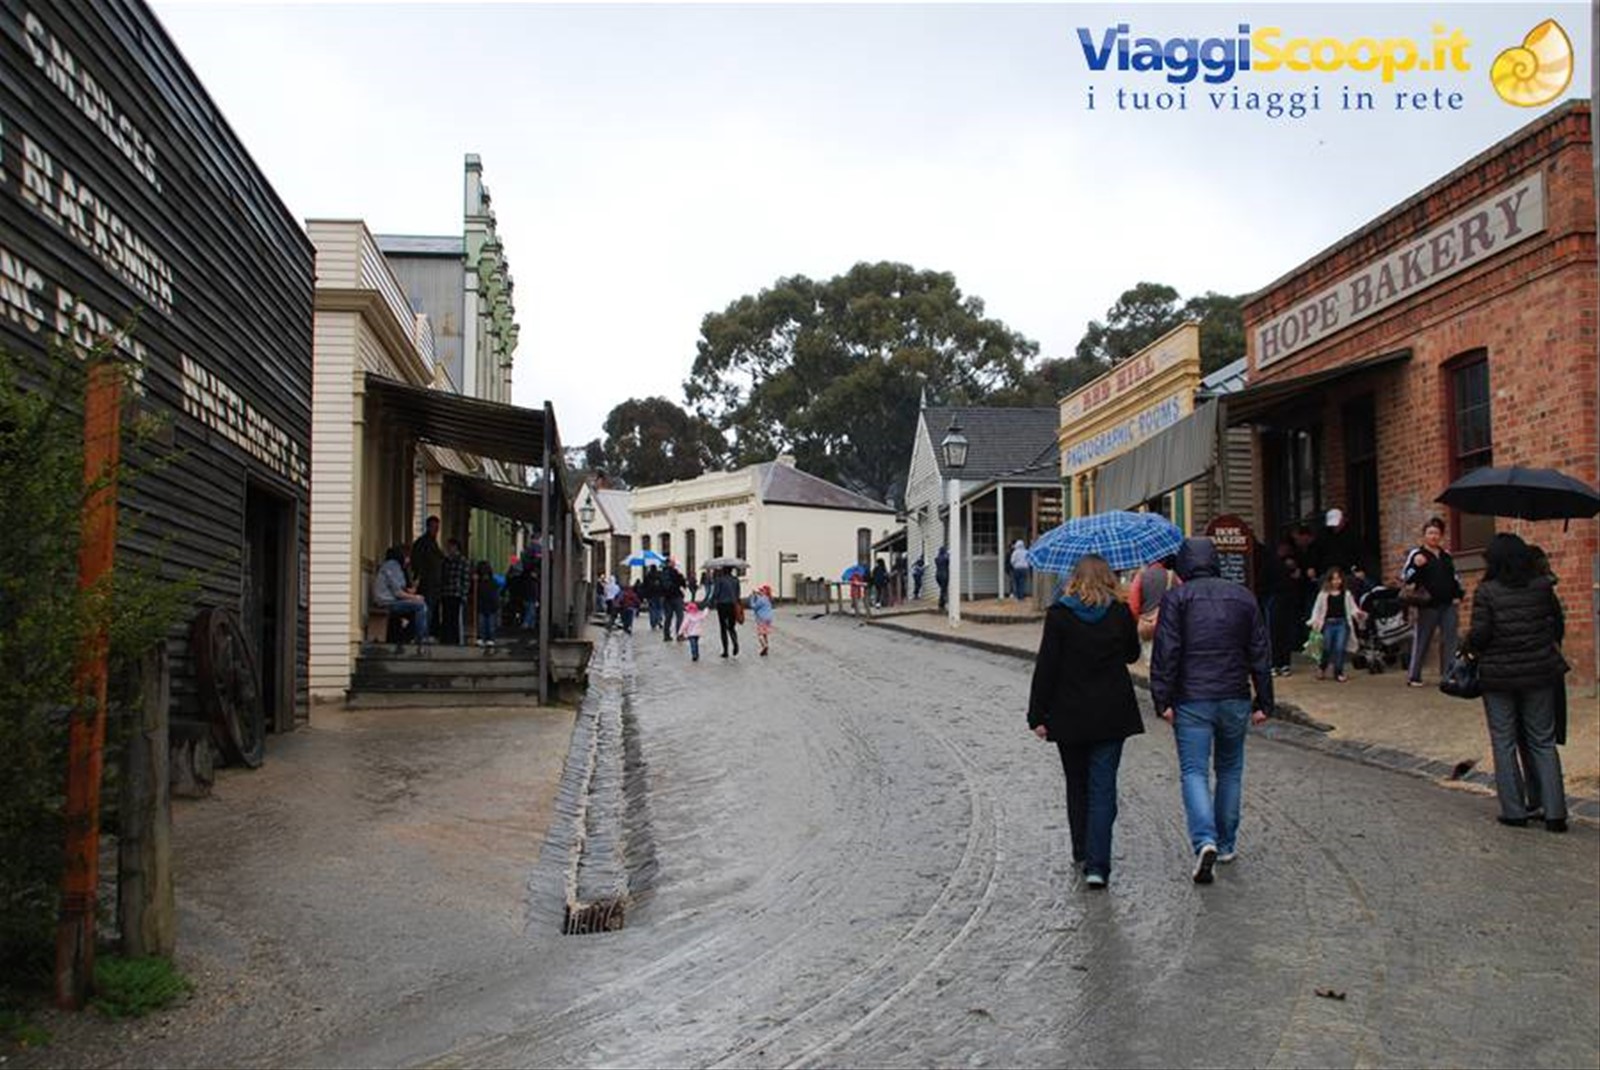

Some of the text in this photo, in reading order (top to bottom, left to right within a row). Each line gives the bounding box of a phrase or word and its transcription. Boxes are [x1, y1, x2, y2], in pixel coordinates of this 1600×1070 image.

[20, 132, 174, 317] BLACKSMITH
[1258, 186, 1530, 363] HOPE BAKERY
[1065, 395, 1180, 468] PHOTOGRAPHIC ROOMS
[1116, 354, 1156, 393] HILL
